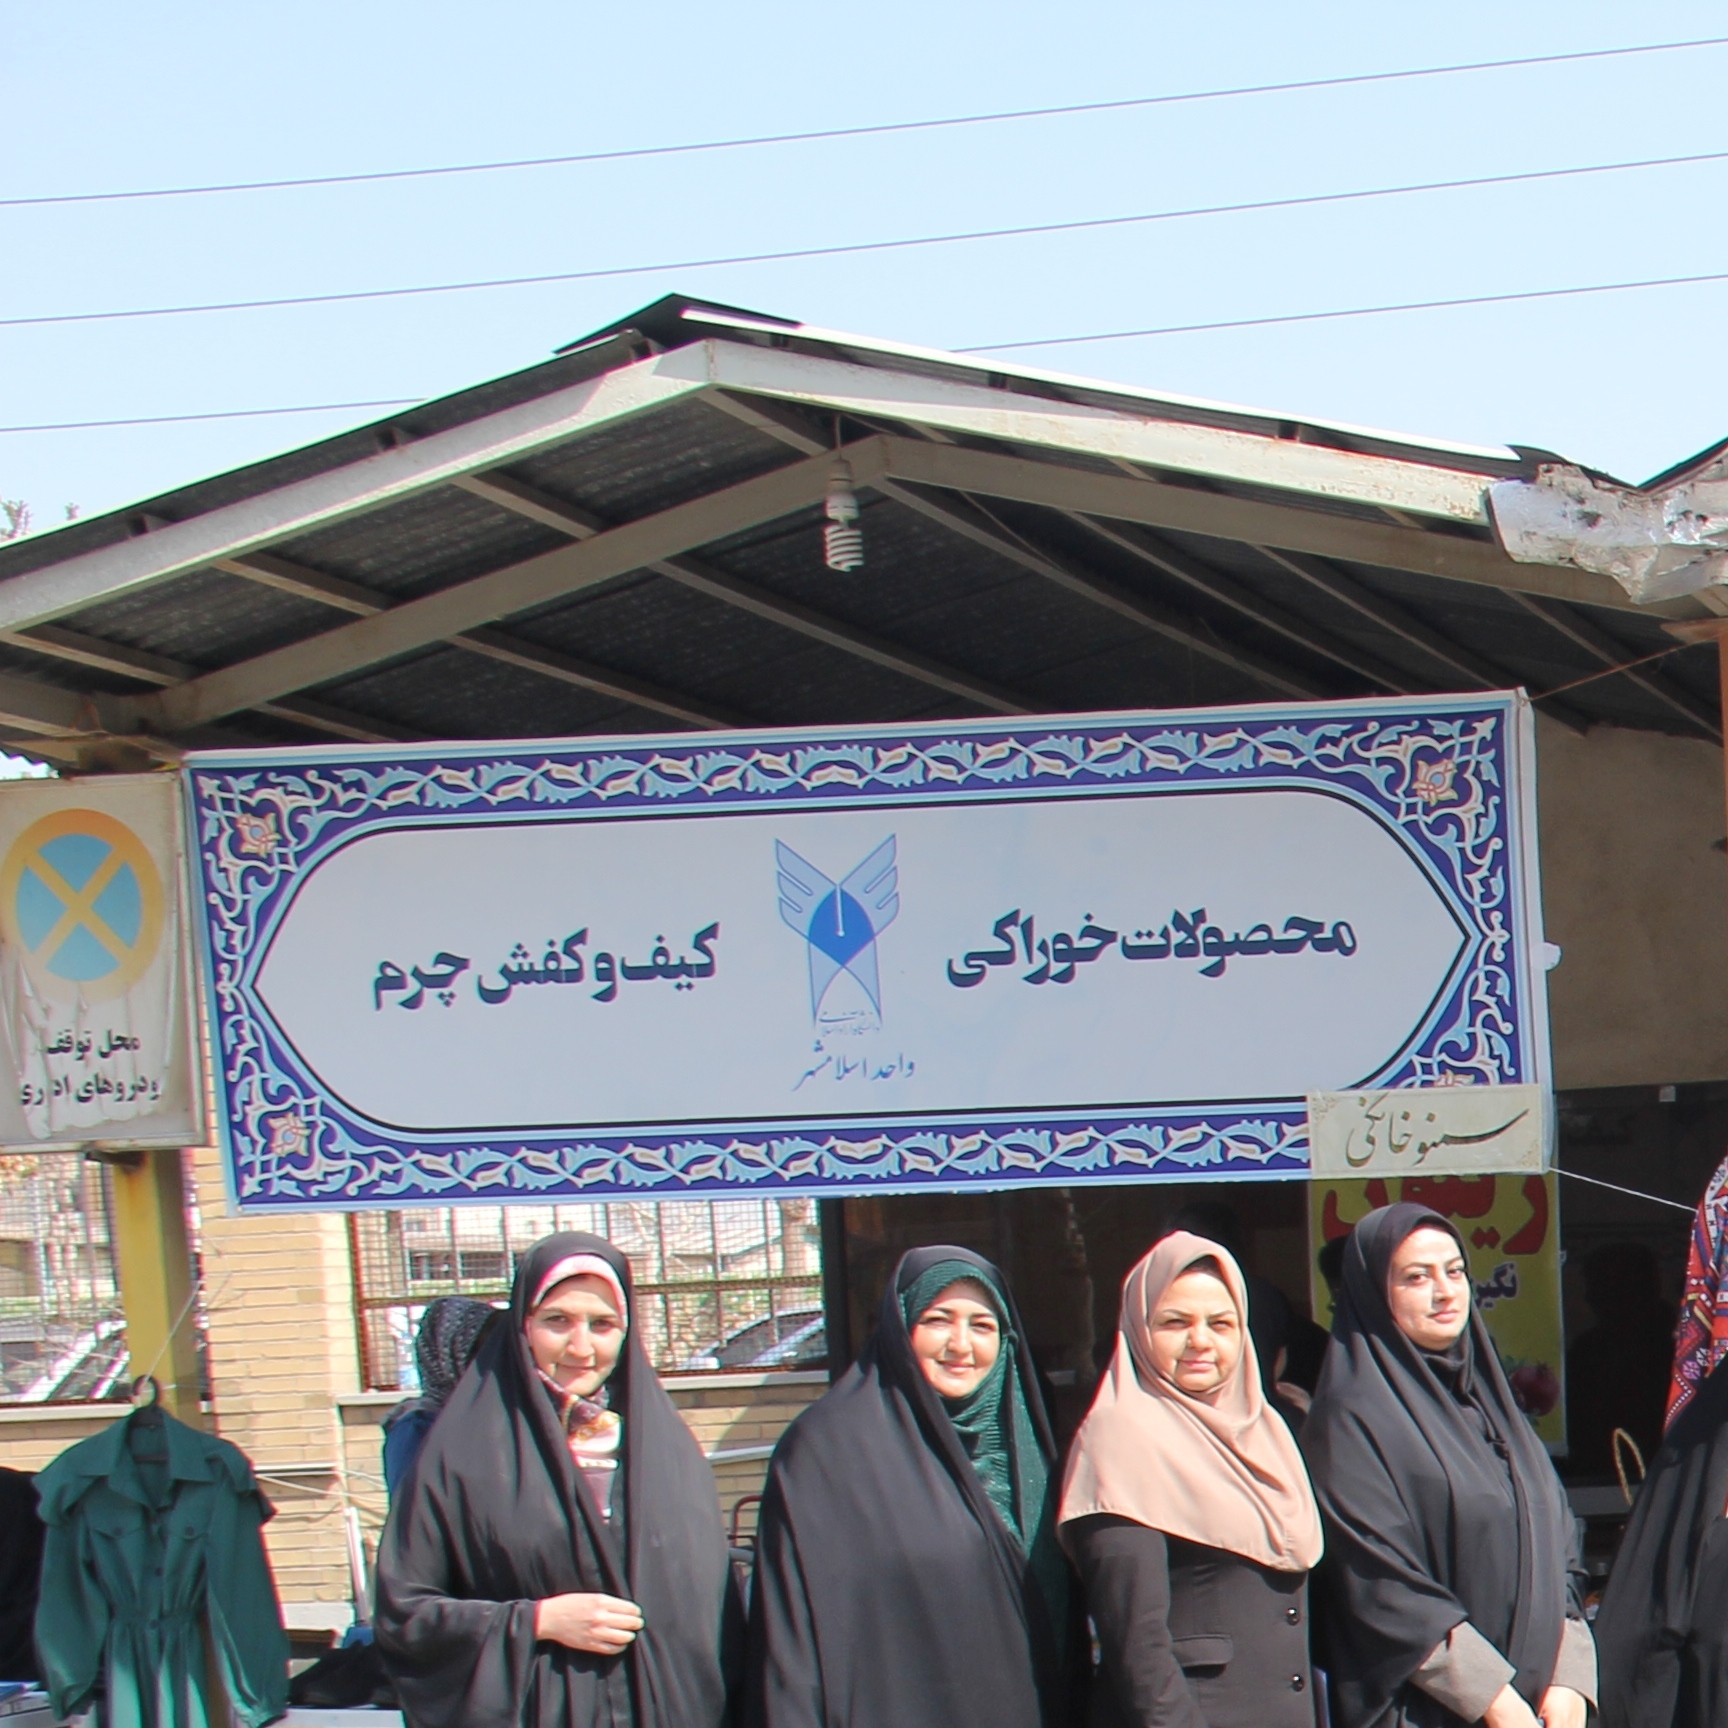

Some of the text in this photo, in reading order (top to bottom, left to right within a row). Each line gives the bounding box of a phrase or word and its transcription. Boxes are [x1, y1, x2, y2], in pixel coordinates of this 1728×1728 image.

[374, 923, 719, 1010] کیف و کفش چرم
[948, 909, 1357, 988] محصولات خوراکی
[98, 1028, 141, 1059] محل
[791, 1039, 915, 1092] واحد اسلامشهر
